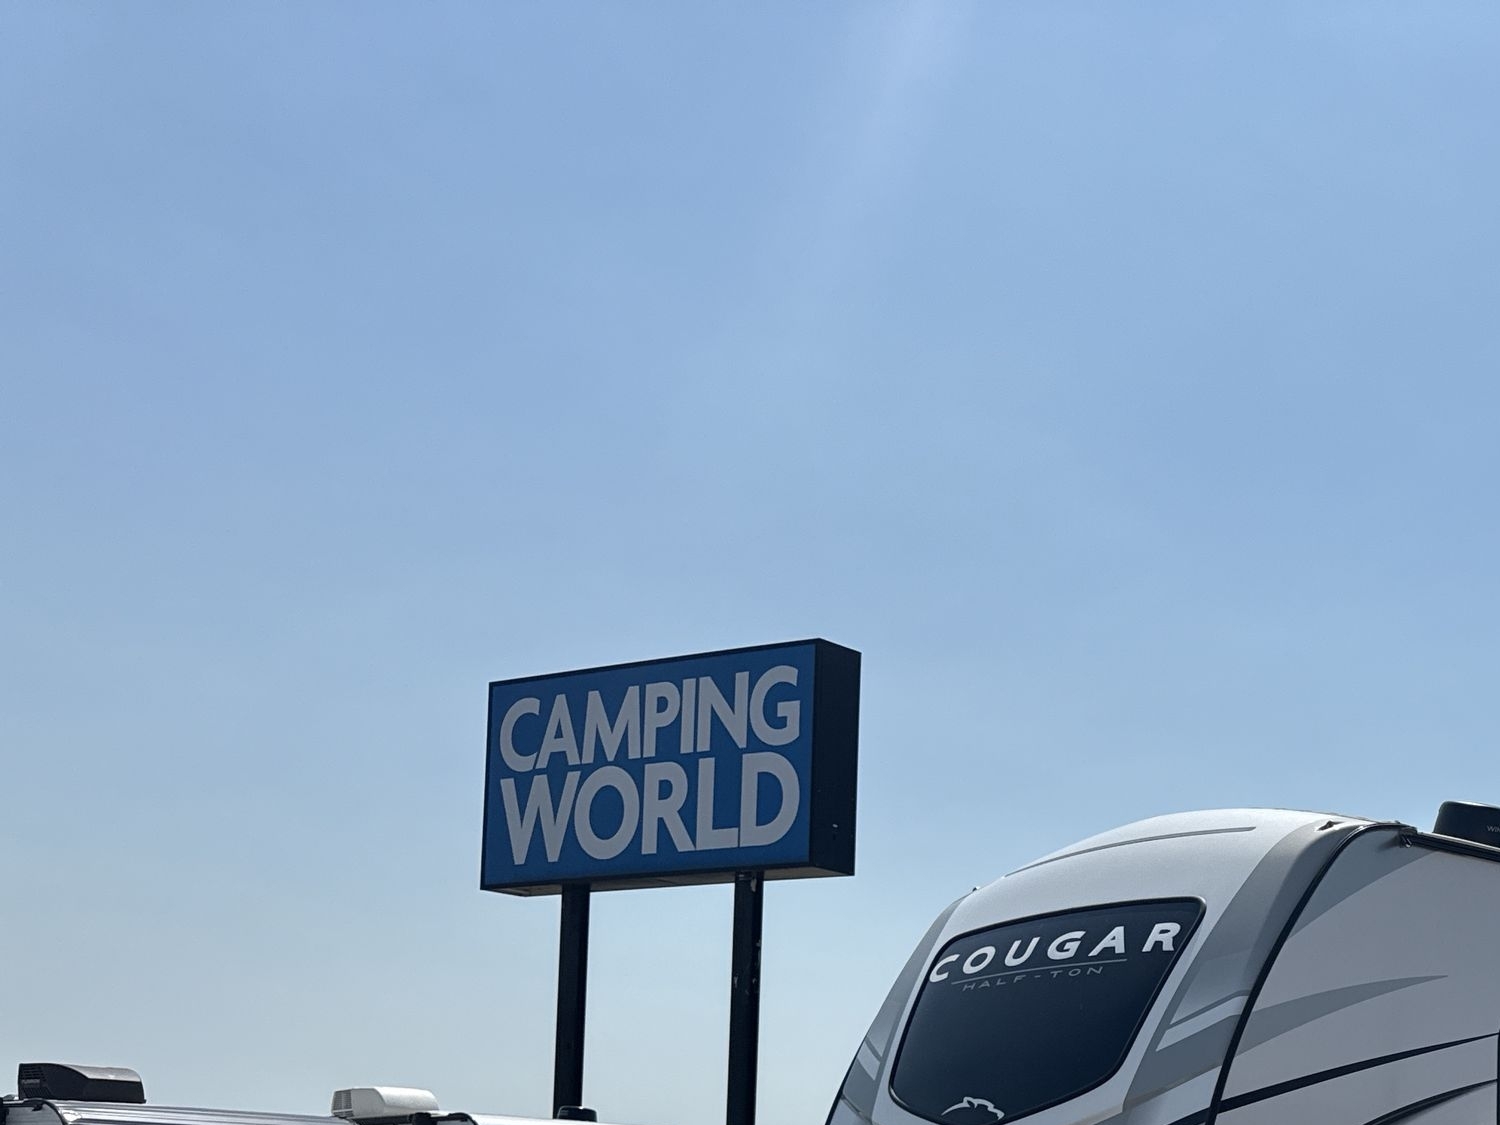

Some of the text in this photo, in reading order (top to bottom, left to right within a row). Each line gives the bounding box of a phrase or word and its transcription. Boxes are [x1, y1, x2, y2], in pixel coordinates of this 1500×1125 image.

[500, 665, 800, 772] CAMPING
[500, 752, 800, 865] WORLD
[929, 922, 1181, 982] COUGAR
[962, 966, 1103, 991] HALF-TON
